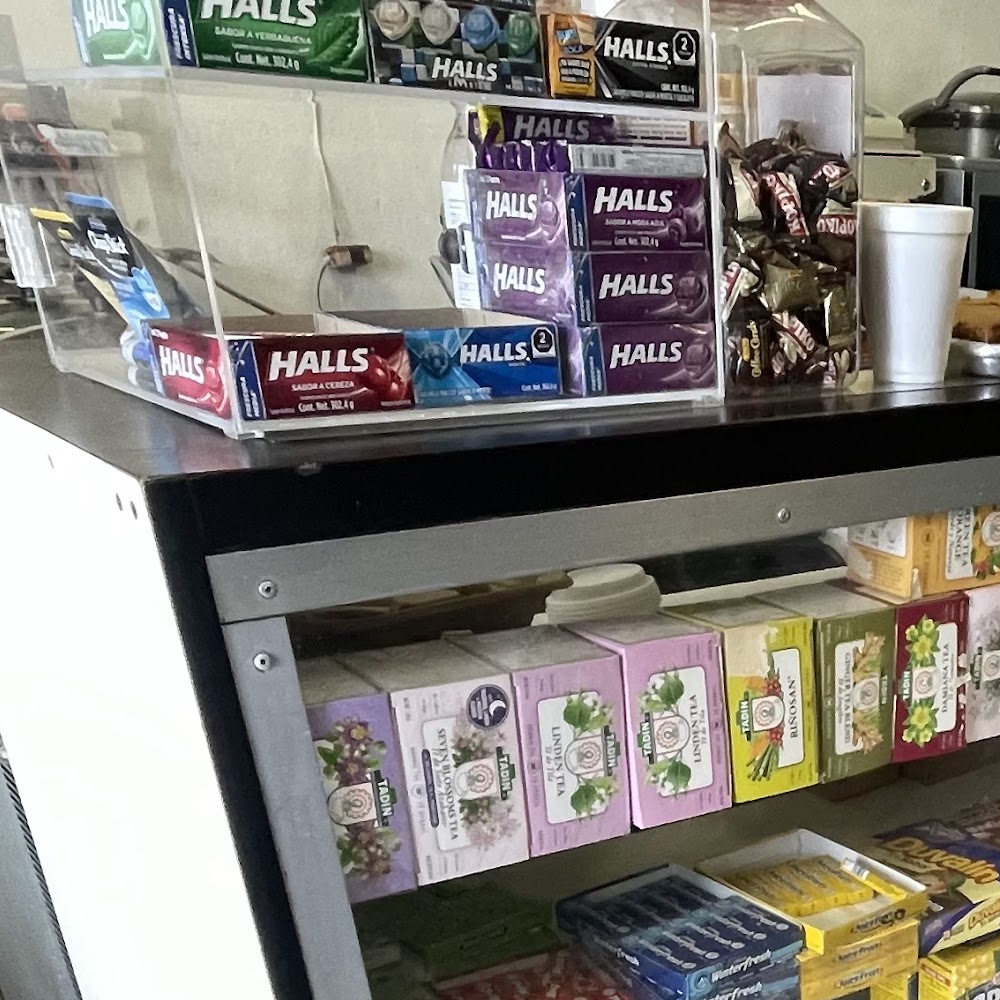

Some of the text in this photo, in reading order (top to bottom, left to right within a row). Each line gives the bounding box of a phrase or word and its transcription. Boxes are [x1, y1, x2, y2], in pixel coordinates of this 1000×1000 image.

[680, 37, 688, 51] 2
[431, 56, 498, 82] HALLS
[513, 115, 590, 140] HALLS
[486, 191, 538, 221] HALLS
[593, 186, 674, 215] HALLS
[816, 217, 856, 236] OPIKO
[493, 262, 546, 298] HALLS
[598, 273, 674, 299] HALLS
[538, 332, 547, 344] 2
[609, 341, 683, 369] HALLS
[159, 344, 205, 385] HALLS
[268, 347, 369, 382] HALLS
[902, 671, 911, 701] TADIN
[940, 643, 951, 713] DAMIANA TEA
[786, 679, 799, 739] RIÑOSAN
[843, 652, 852, 744] GINGER TEA BLEND
[688, 694, 702, 763] LINDEN TEA
[741, 699, 750, 734] TADIN
[606, 732, 617, 769] TADIN
[640, 721, 653, 757] TADIN
[499, 753, 513, 793] TADIN
[551, 726, 566, 797] LINDEN TEA
[376, 779, 394, 818] TADIN
[437, 728, 461, 840] SEVEN BLOSSOMS TEA
[711, 949, 772, 983] Winterfresh
